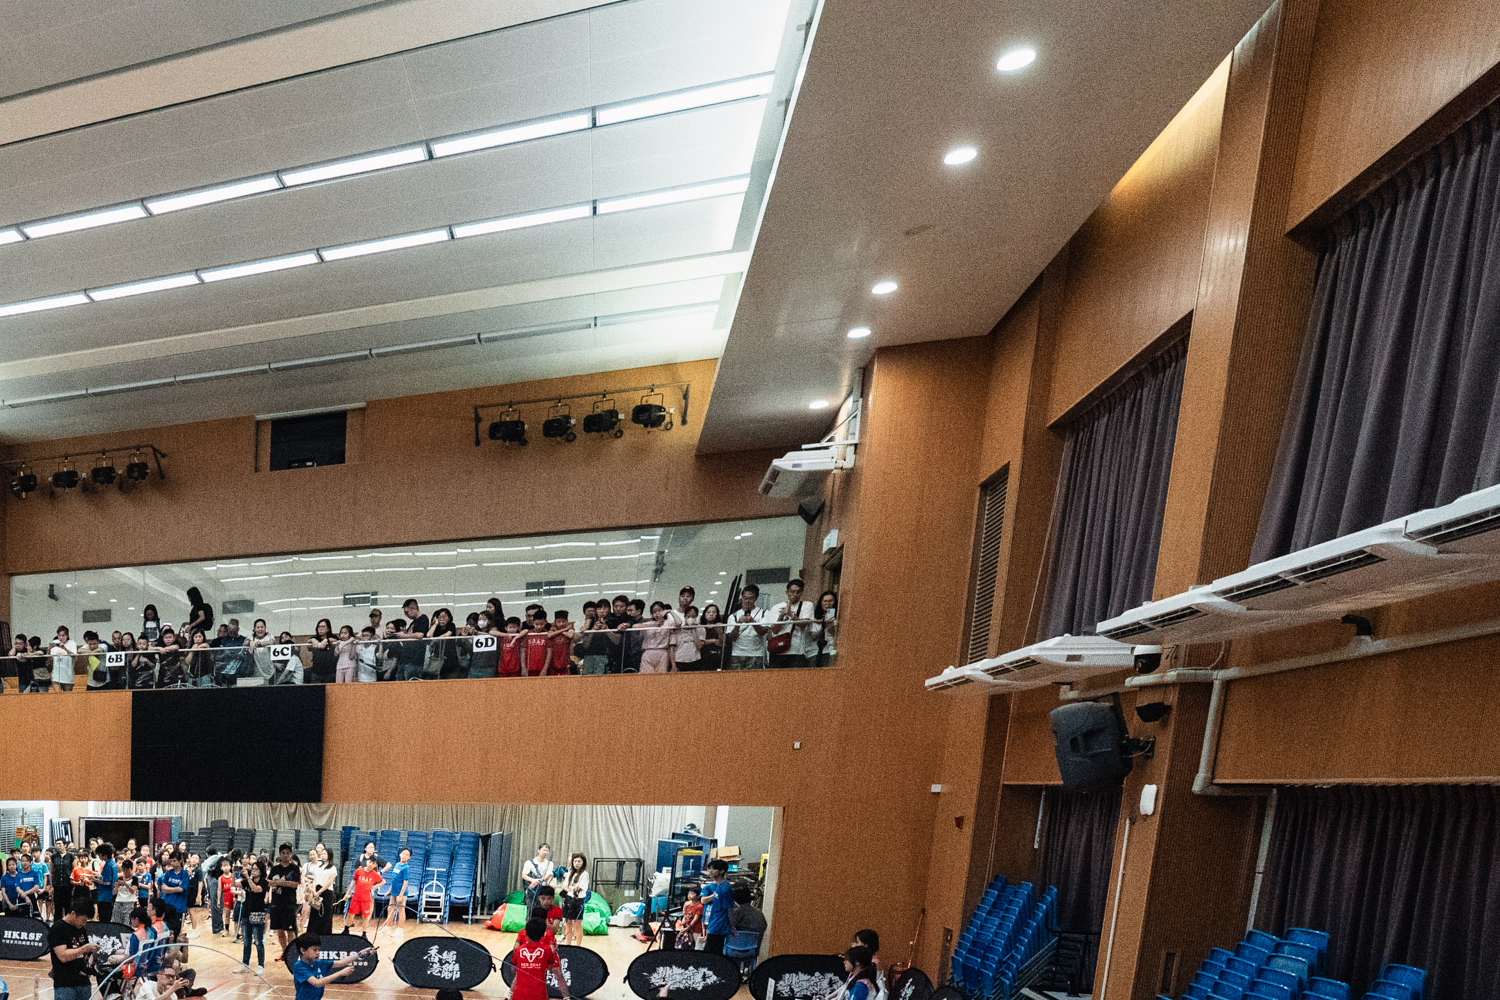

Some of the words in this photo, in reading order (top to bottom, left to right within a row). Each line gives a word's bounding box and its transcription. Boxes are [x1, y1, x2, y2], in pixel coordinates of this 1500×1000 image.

[475, 638, 495, 648] 6D
[272, 647, 290, 657] 6C
[108, 653, 123, 664] 6B
[3, 930, 43, 940] HKRSF
